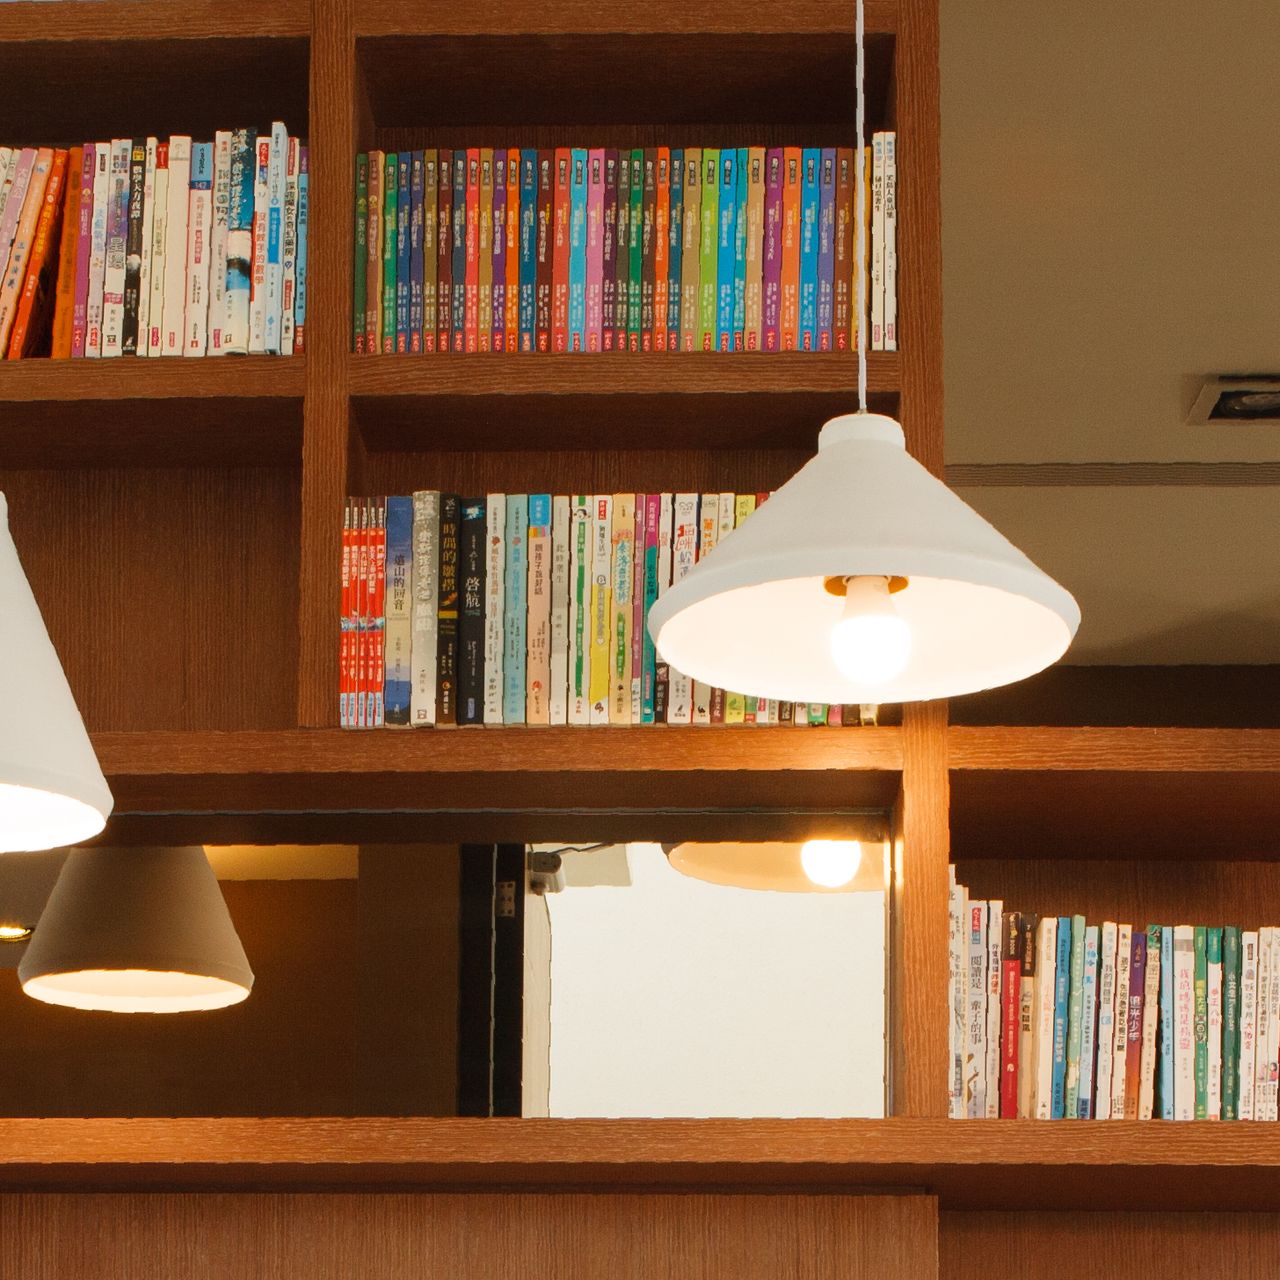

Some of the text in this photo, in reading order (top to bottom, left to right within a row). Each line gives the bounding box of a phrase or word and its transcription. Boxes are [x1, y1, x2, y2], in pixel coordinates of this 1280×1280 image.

[393, 554, 406, 611] 遠山的回音
[970, 955, 983, 1046] 閱讀是一輩子的事
[1129, 995, 1142, 1042] 追光少年
